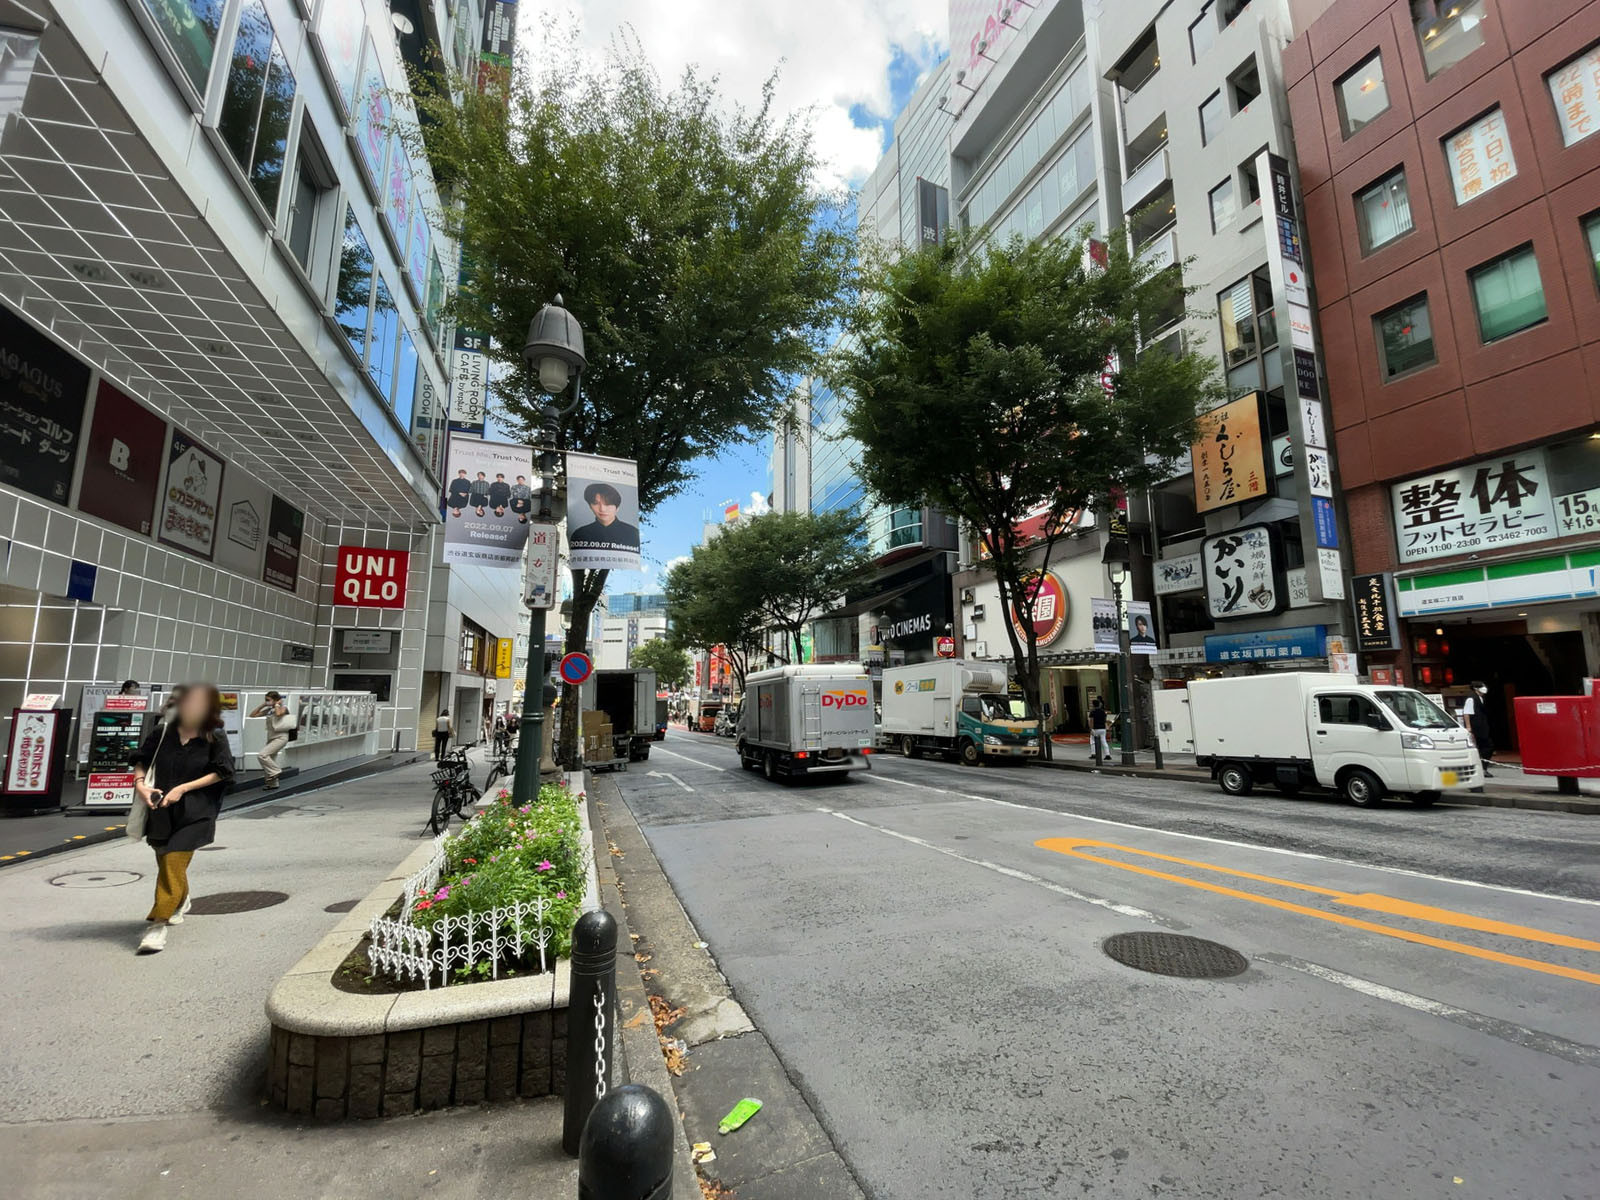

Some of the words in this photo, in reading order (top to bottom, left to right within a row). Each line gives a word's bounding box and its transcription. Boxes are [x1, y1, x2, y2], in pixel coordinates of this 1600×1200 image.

[464, 337, 481, 349] 3F
[471, 354, 481, 388] LIVING
[468, 390, 479, 421] ROOM
[39, 438, 70, 463] ダーツ
[109, 438, 131, 471] B
[173, 441, 185, 453] 4F
[493, 453, 512, 461] Trust
[603, 467, 620, 475] Trust
[1308, 453, 1321, 488] かいり
[1400, 460, 1539, 529] 整体
[470, 531, 508, 541] Release!
[1403, 510, 1545, 547] フットセラピー
[1406, 547, 1428, 556] OPEN
[1499, 526, 1548, 541] 3462-7003
[570, 541, 610, 549] 2022.09.07
[611, 543, 639, 552] Release!
[346, 554, 396, 576] UNI
[1212, 536, 1245, 613] かいり
[343, 577, 398, 602] QLO
[896, 613, 932, 637] CINEMAS
[1035, 617, 1063, 646] AMUSEMENT
[822, 695, 868, 710] DyDo
